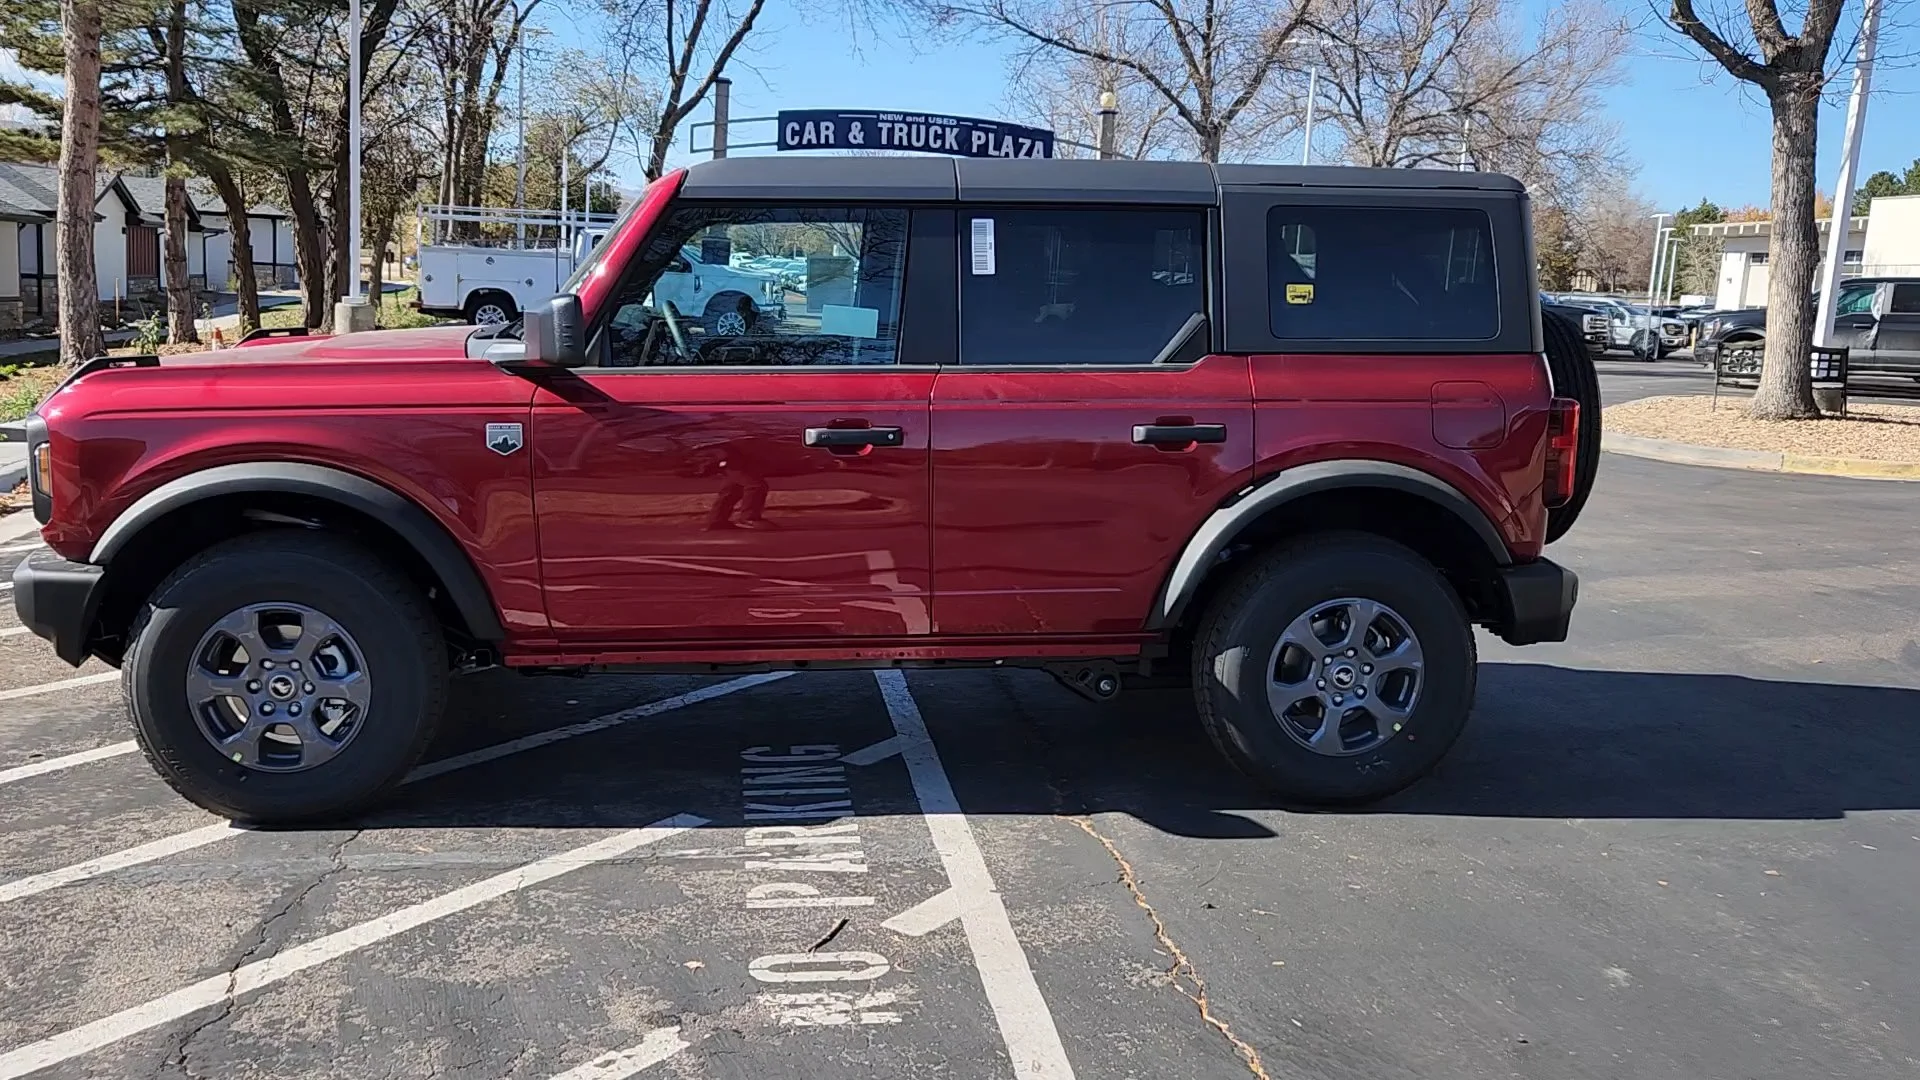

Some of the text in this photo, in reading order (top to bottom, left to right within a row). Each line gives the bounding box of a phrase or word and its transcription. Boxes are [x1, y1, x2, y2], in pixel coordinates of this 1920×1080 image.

[879, 113, 903, 121] NEW
[928, 116, 957, 126] USED
[785, 121, 1044, 159] CAR & TRUCK PLAZA
[740, 744, 903, 1026] NO PARKING
